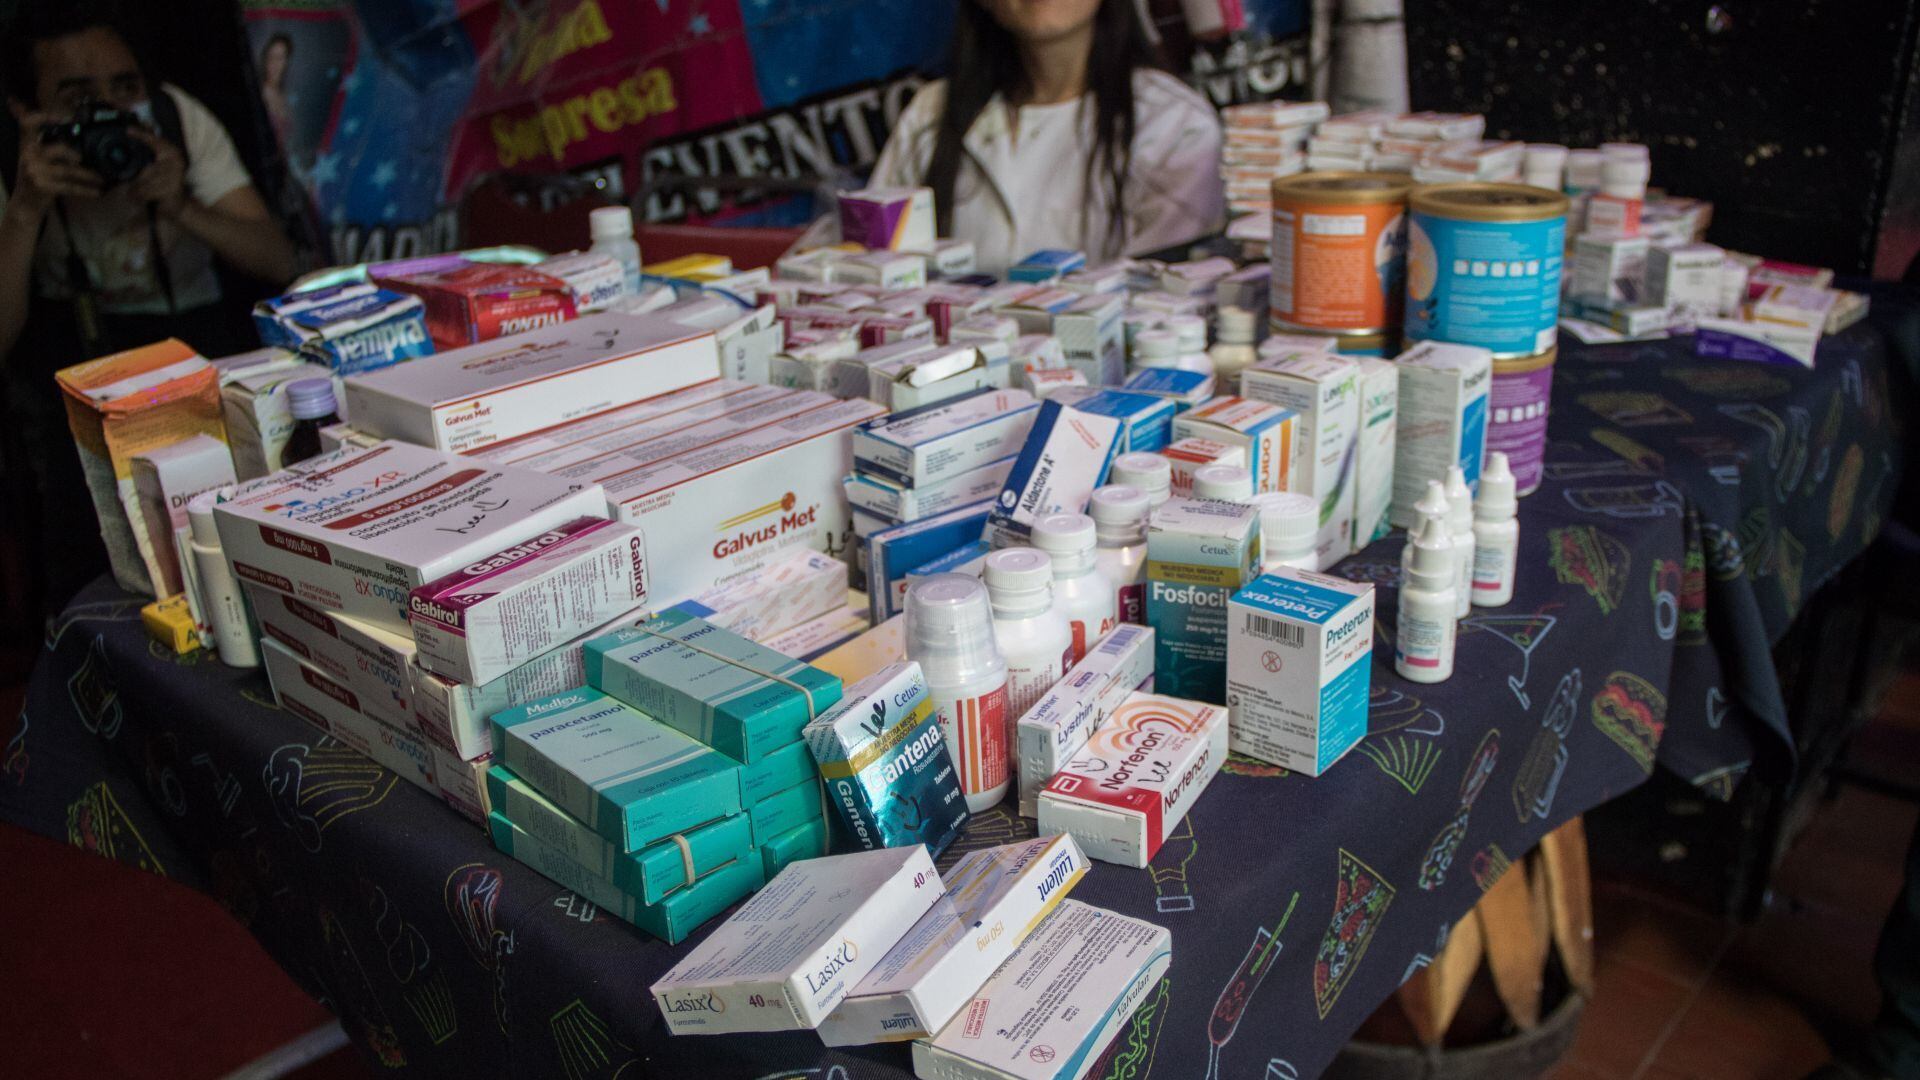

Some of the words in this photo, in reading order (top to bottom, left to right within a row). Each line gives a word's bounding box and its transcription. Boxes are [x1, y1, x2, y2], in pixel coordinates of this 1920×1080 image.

[445, 412, 473, 427] Galvus
[474, 408, 491, 419] Met
[886, 411, 942, 432] Aldactone
[364, 471, 406, 489] XR
[1022, 466, 1051, 514] Aldactone
[349, 508, 421, 537] Clorhidrato
[422, 503, 434, 512] de
[436, 473, 504, 505] metformina
[359, 515, 422, 540] liberación
[425, 487, 492, 518] prolongada
[631, 497, 655, 511] MUESTRA
[640, 499, 671, 514] NEGOCIABLE
[713, 524, 777, 559] Galvus
[781, 505, 816, 534] Met
[463, 529, 568, 575] Gabirol
[1201, 545, 1229, 555] Cetus
[629, 535, 646, 598] Gabirol
[1160, 564, 1194, 572] MUESTRA
[1176, 573, 1221, 582] NEGOCIABLE
[354, 577, 372, 597] XR
[1153, 582, 1230, 607] Fosfocil
[411, 596, 459, 626] Gabirol
[1246, 590, 1328, 620] Preterax
[1186, 624, 1198, 632] 250
[1326, 607, 1370, 649] Preterax
[526, 694, 578, 718] Medley
[894, 684, 918, 708] Cetus
[1028, 694, 1059, 720] Lysthin
[529, 704, 628, 741] paracetamol
[598, 727, 613, 736] mg
[1058, 703, 1093, 745] Lysthin
[868, 724, 939, 793] Gantena
[1100, 731, 1165, 791] Norfenon
[934, 766, 951, 784] Tabletas
[1164, 749, 1209, 815] Norfenon
[950, 787, 960, 799] mg
[837, 780, 873, 849] Ganten
[913, 872, 925, 889] 40
[924, 866, 935, 881] mg
[1038, 855, 1074, 902] Lullent
[991, 920, 1004, 940] 150
[976, 937, 991, 953] mg
[805, 952, 844, 996] Lasix
[662, 992, 705, 1014] Lasix
[749, 993, 764, 1008] 40
[767, 998, 783, 1009] mg
[1117, 974, 1150, 1017] Valvulan
[881, 1016, 917, 1030] Lullent
